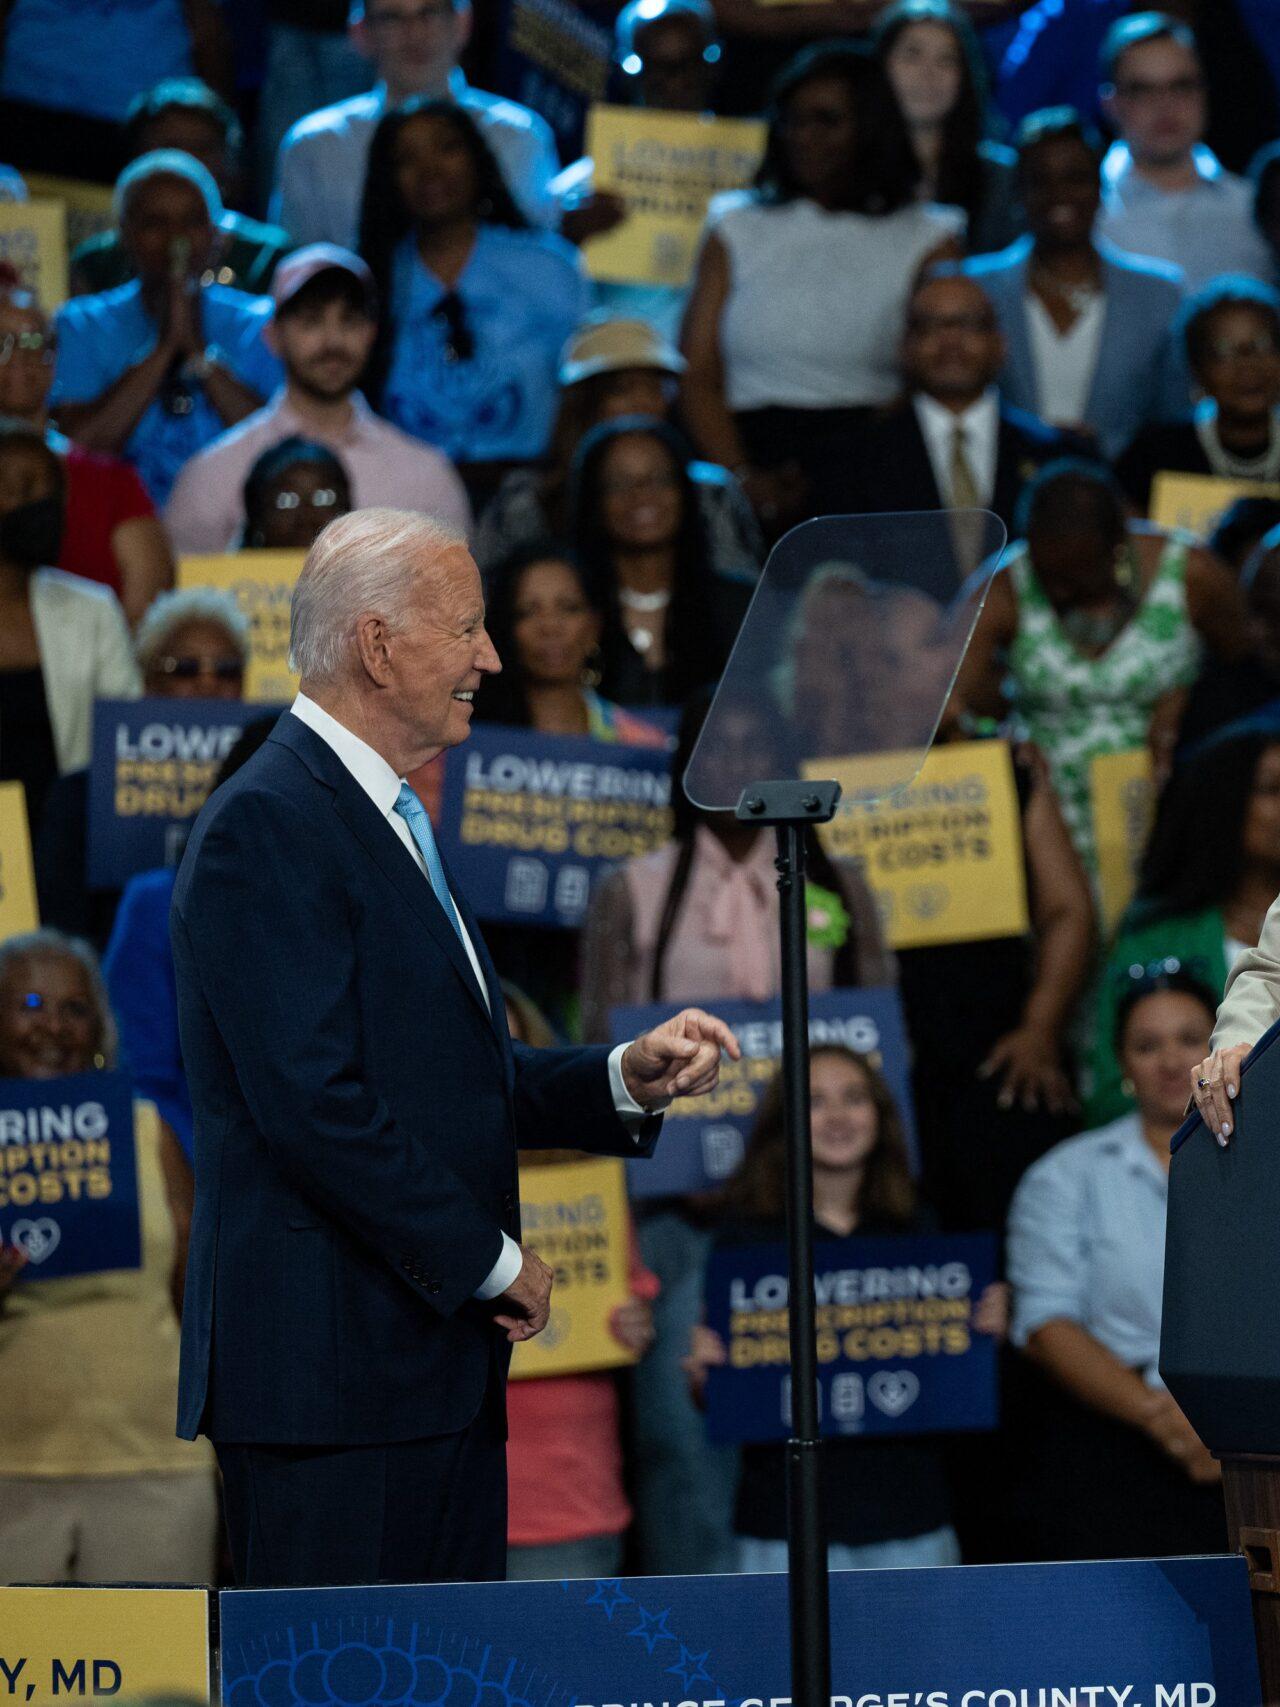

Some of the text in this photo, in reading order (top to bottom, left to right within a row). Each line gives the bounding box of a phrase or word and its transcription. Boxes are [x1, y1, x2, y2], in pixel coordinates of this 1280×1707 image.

[466, 753, 672, 806] LOWERIN
[0, 1101, 109, 1145] RING
[730, 1319, 971, 1369] DRG COSTS
[52, 1659, 122, 1696] MD
[961, 1685, 1141, 1707] COUNTY
[1155, 1683, 1216, 1707] MD
